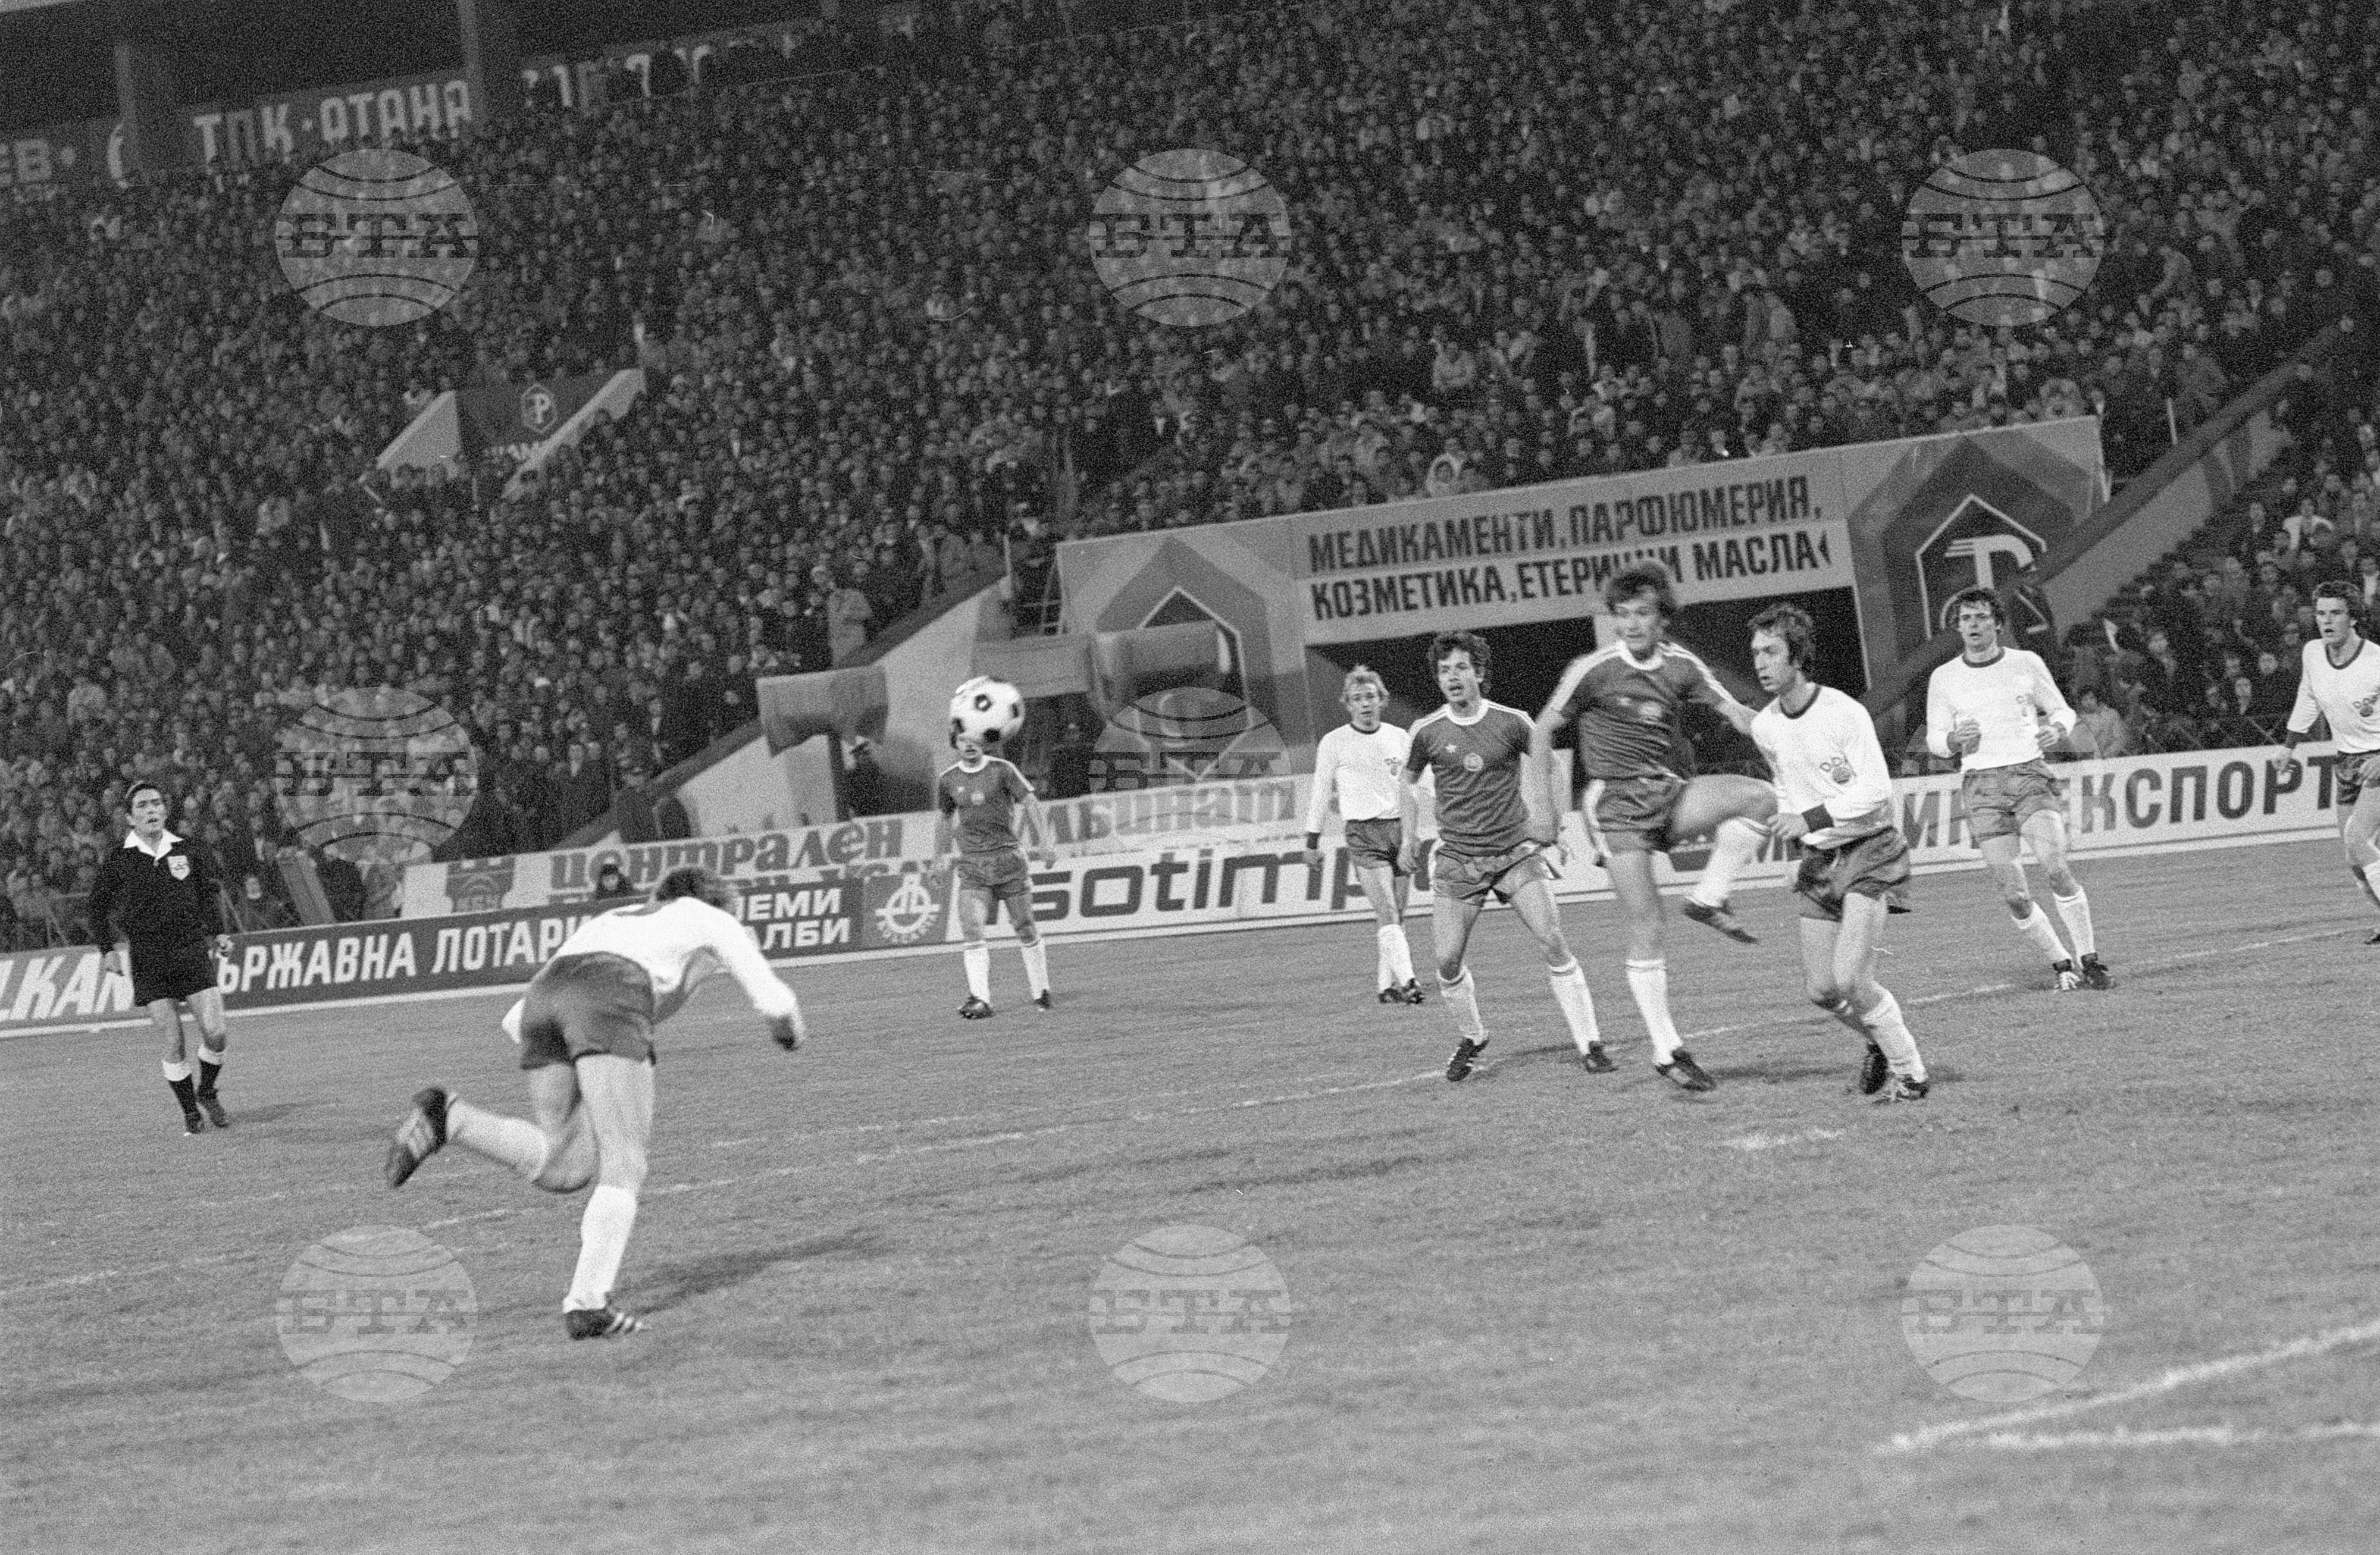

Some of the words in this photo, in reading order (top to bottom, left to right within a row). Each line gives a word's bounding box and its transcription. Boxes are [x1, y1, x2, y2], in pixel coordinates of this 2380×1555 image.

[1310, 565, 1517, 621] КОЗМЕТИКА,
[1692, 531, 1819, 582] МАСЛА
[734, 888, 841, 921] ЕМИ
[217, 932, 417, 994] ЪРЖАВНА
